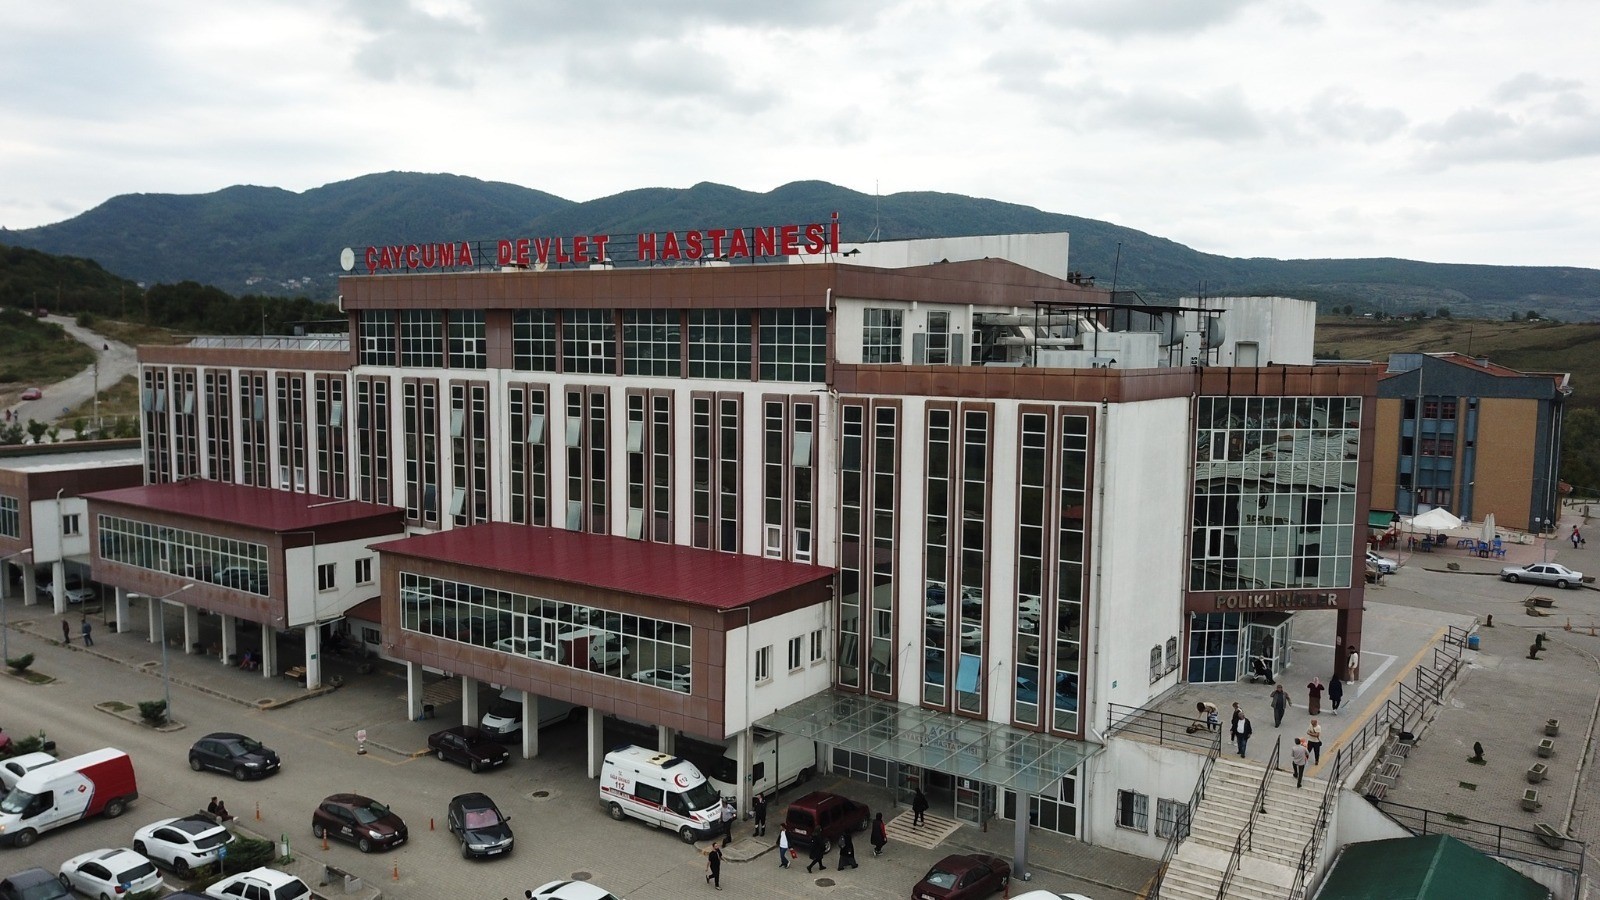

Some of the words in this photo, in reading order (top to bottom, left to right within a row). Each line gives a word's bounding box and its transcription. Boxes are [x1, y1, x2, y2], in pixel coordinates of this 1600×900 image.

[365, 241, 474, 275] ÇAYCUMA
[497, 234, 609, 266] DEVLET
[638, 212, 839, 261] HASTANESİ
[615, 781, 625, 791] 112
